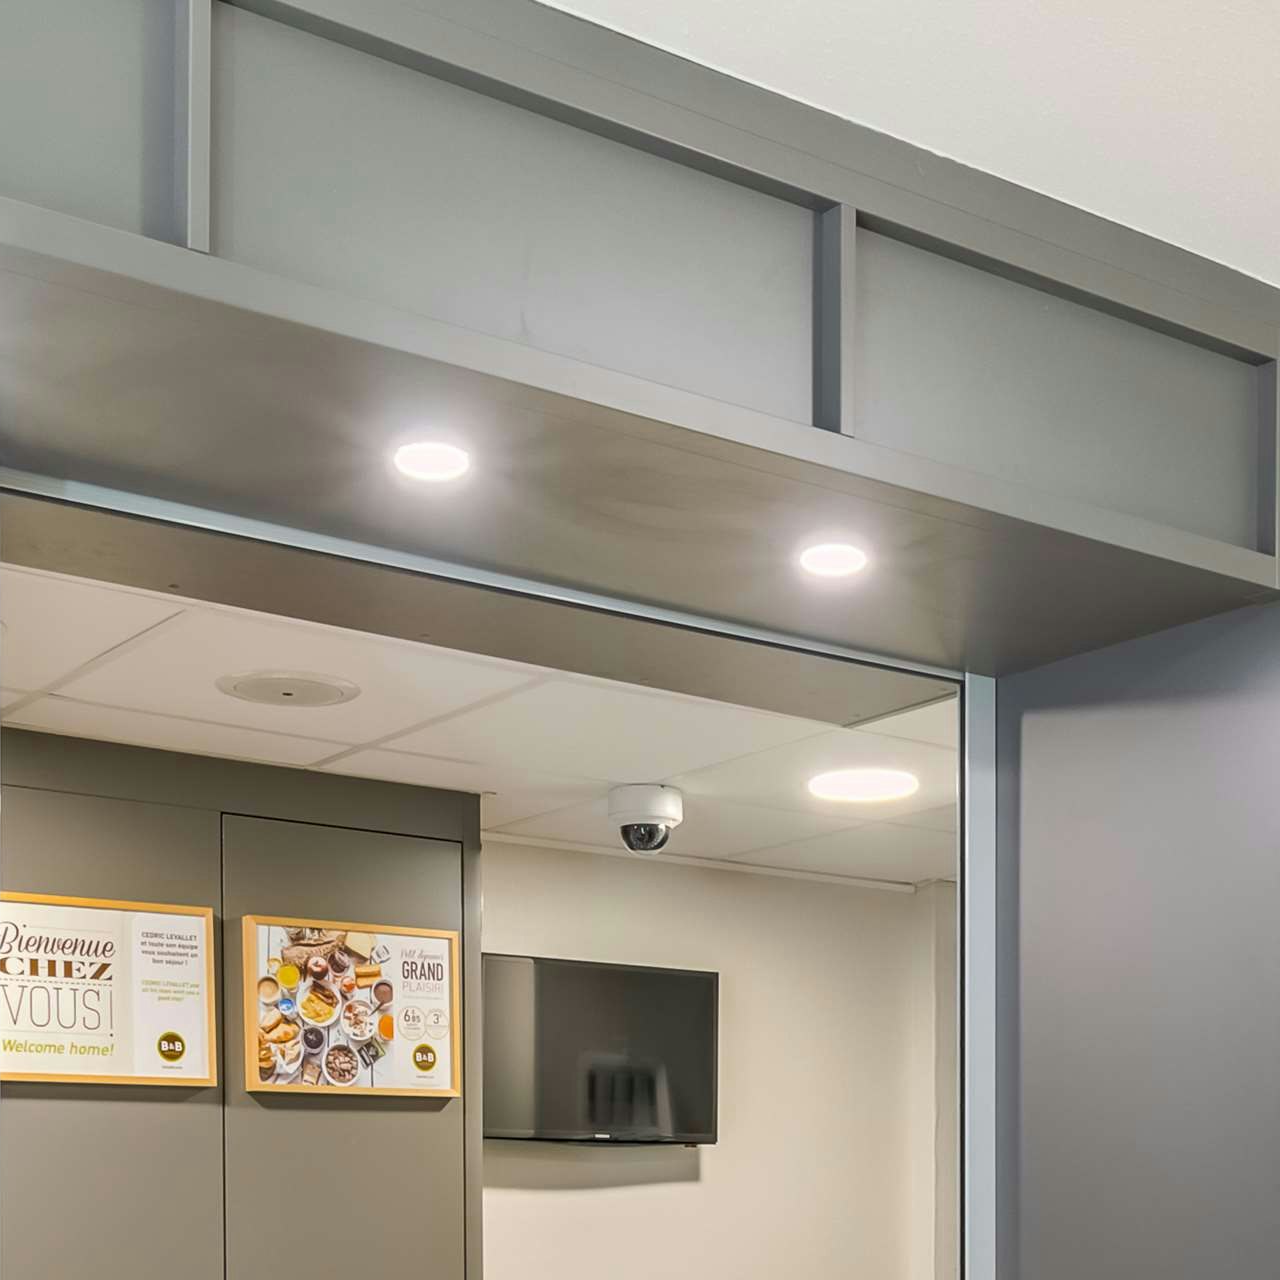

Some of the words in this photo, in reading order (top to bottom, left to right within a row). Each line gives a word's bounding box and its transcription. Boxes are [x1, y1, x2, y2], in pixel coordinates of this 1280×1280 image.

[0, 921, 116, 958] Bienvenue
[0, 956, 113, 981] CHEZ
[402, 960, 444, 982] GRAND
[2, 1039, 65, 1054] Welcome
[69, 1041, 114, 1056] home!
